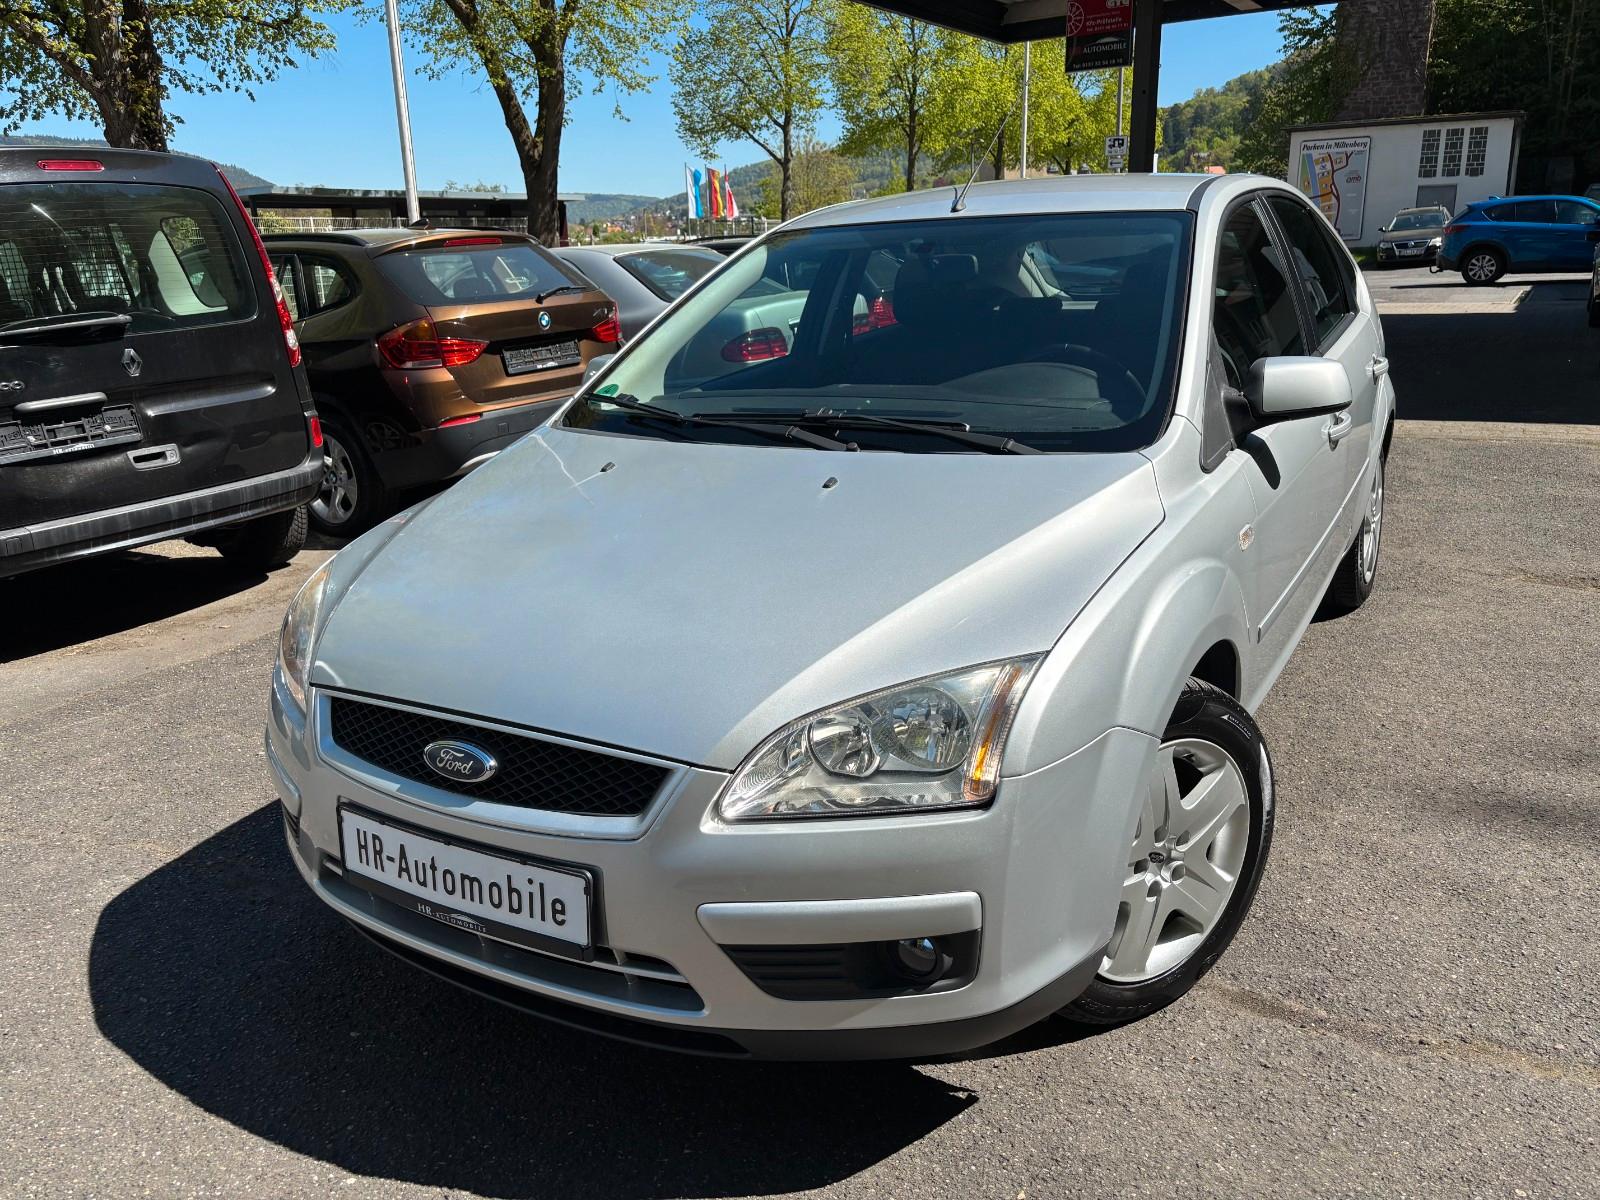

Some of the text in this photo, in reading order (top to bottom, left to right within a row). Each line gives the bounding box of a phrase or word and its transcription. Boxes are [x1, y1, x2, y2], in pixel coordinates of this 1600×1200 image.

[1083, 42, 1128, 53] AUTOMOBILE
[1334, 140, 1368, 150] Miltenberg
[436, 748, 474, 775] Ford
[356, 828, 567, 926] HR-Automobile
[417, 902, 487, 933] HR-AUTOMOBILE
